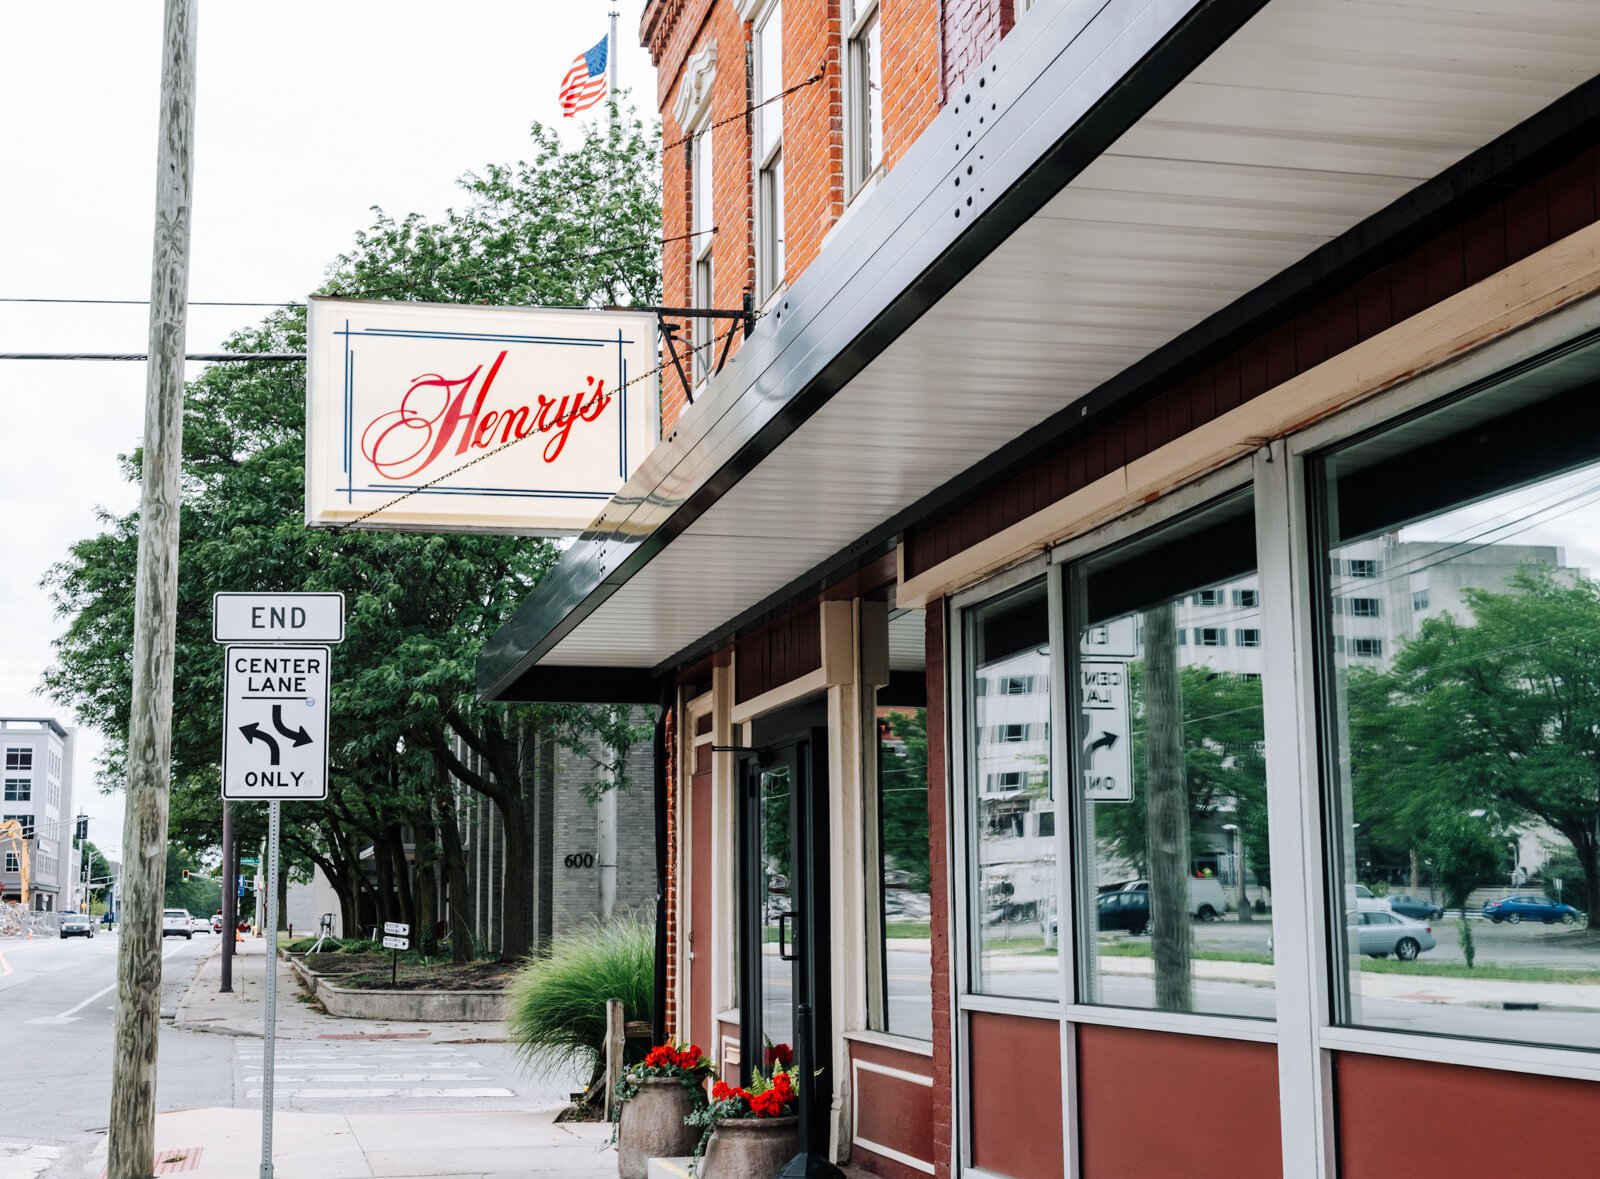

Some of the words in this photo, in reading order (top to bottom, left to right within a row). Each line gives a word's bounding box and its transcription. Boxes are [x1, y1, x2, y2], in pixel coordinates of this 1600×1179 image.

[361, 350, 612, 480] Henry's
[252, 607, 306, 628] END
[235, 658, 320, 674] CENTER
[248, 677, 306, 692] LANE
[245, 771, 305, 787] ONLY
[564, 853, 593, 868] 600
